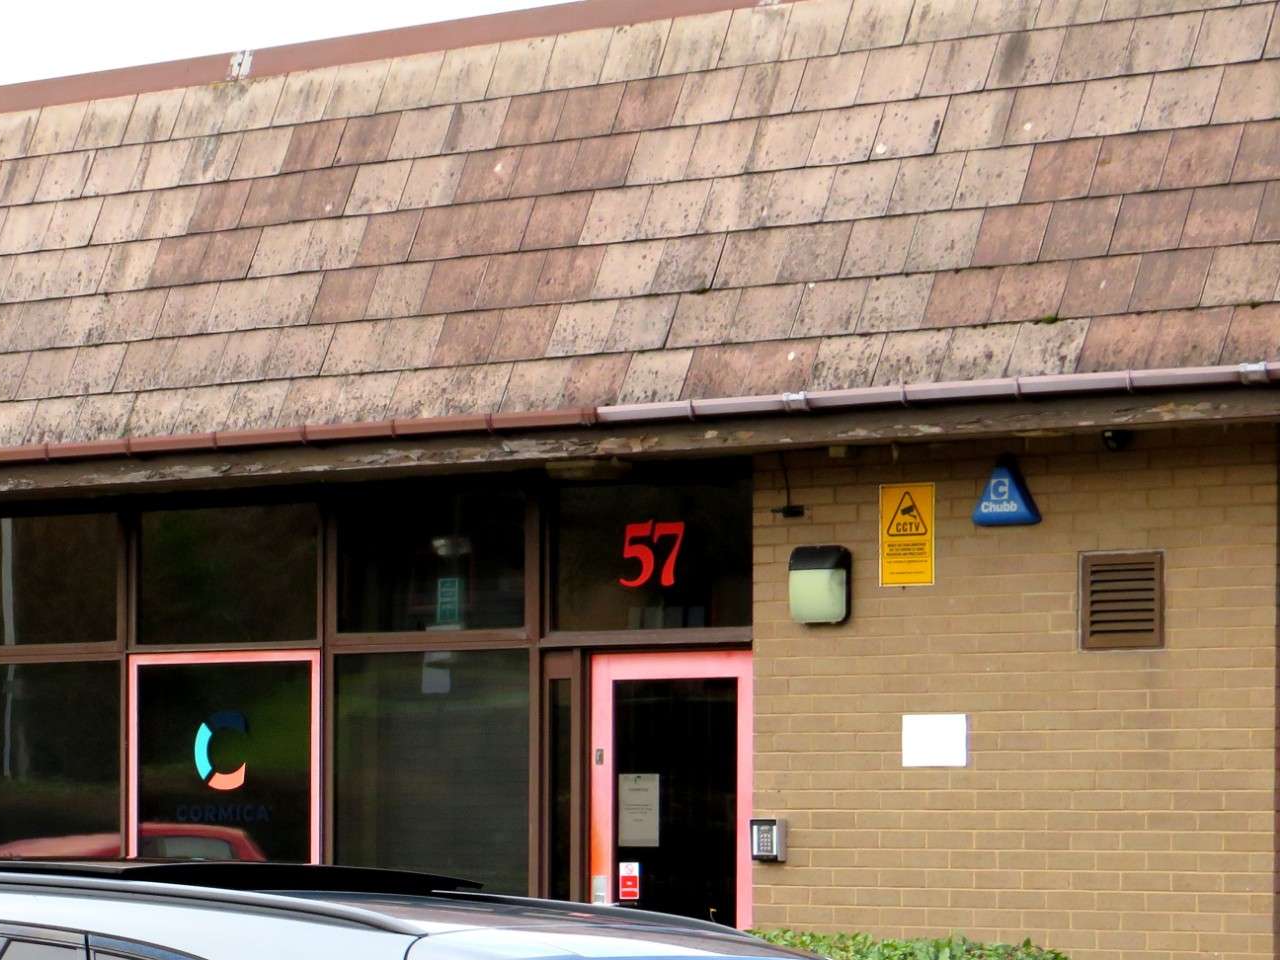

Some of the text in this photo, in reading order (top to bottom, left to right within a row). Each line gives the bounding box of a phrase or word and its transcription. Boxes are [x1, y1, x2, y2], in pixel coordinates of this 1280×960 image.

[981, 500, 1018, 513] Chubb
[896, 521, 921, 533] CCTV
[619, 519, 685, 587] 57
[176, 803, 271, 823] CORMICA
